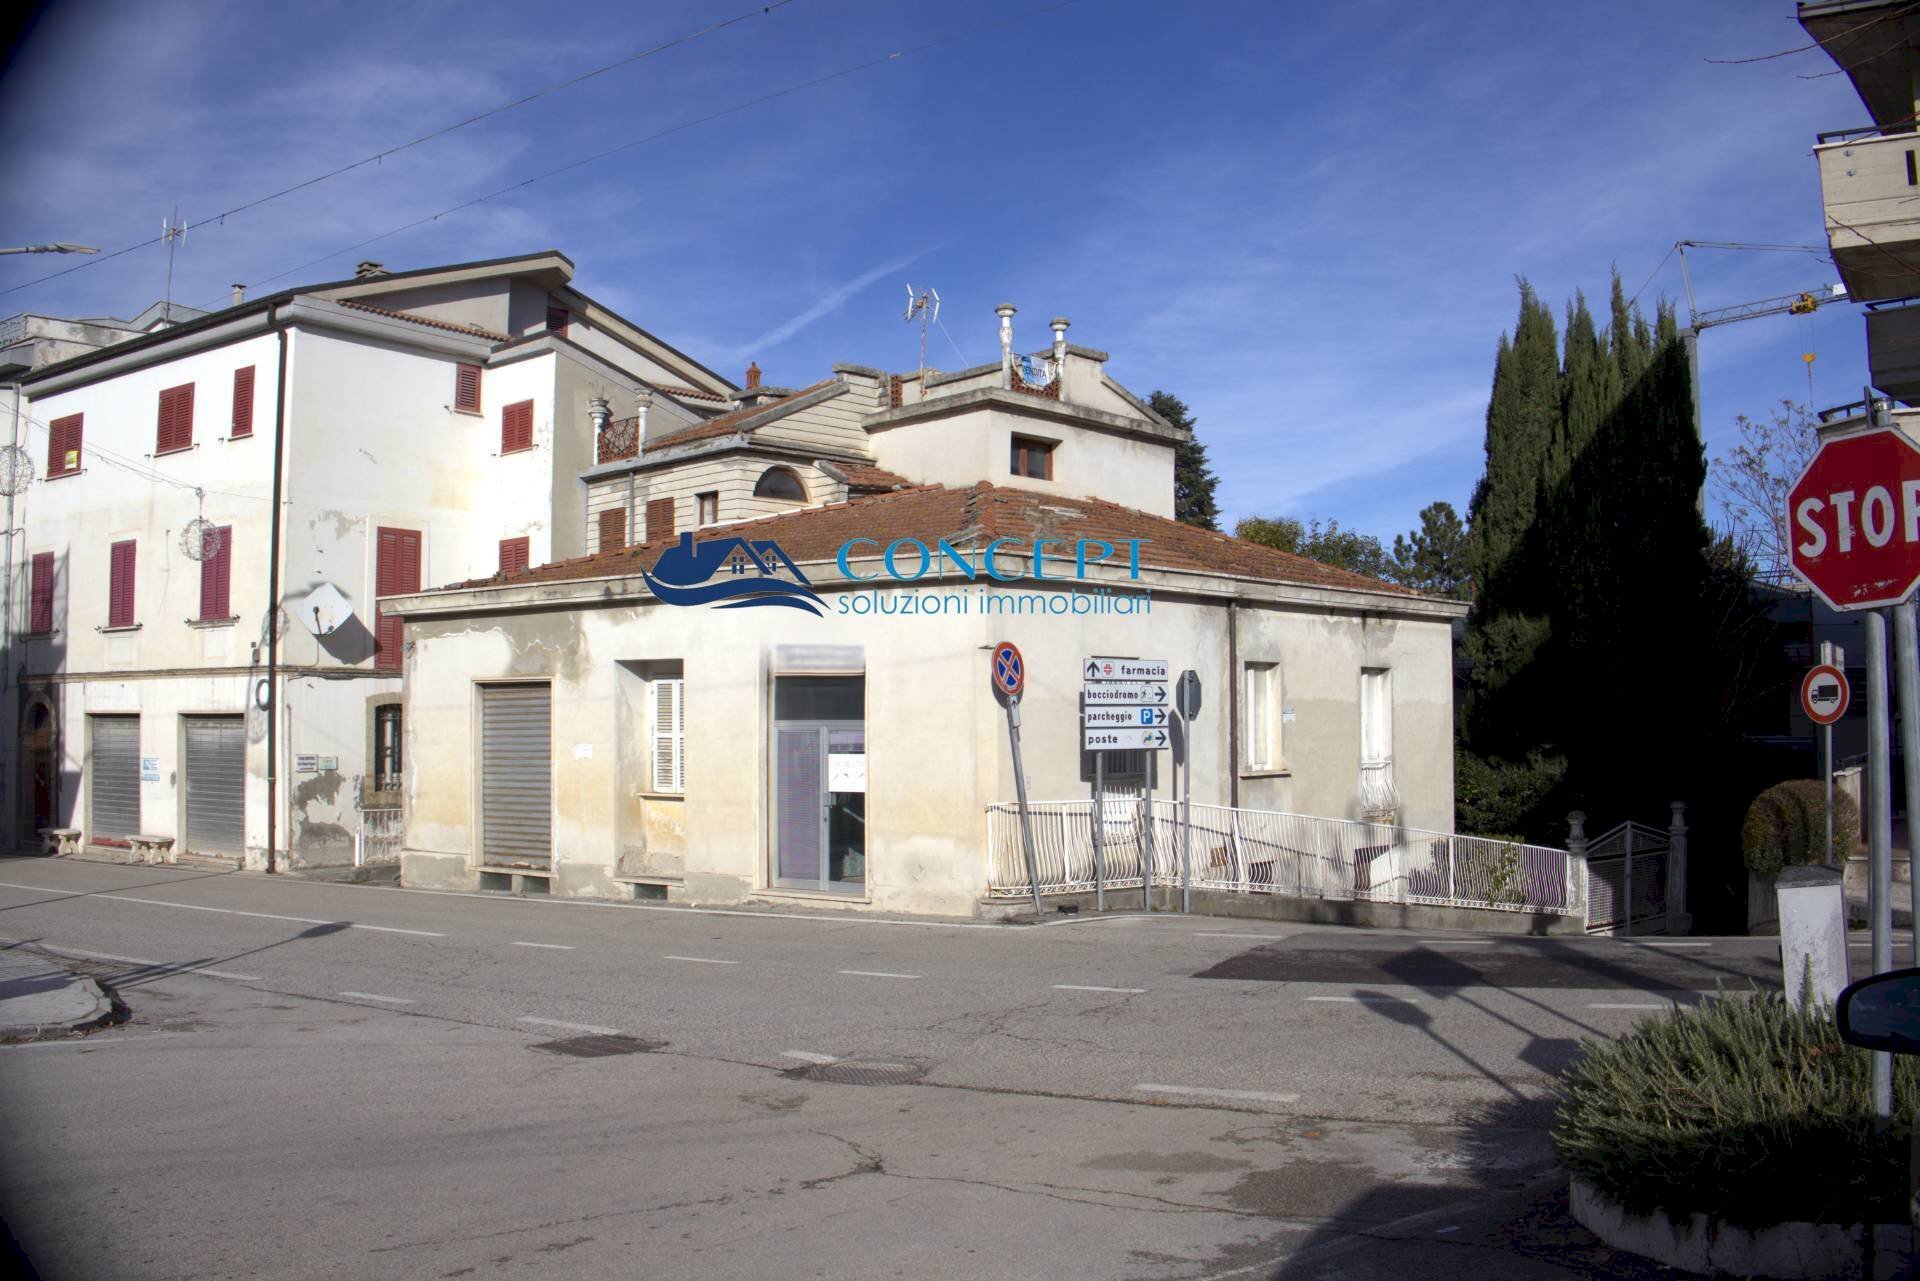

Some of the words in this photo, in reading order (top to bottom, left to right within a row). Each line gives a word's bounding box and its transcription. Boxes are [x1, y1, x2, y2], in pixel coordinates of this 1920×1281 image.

[1121, 665, 1166, 676] farmacia
[1087, 689, 1139, 699] bocciodromo
[1087, 711, 1132, 723] parcheggio
[1143, 710, 1150, 722] P
[1088, 734, 1118, 745] poste
